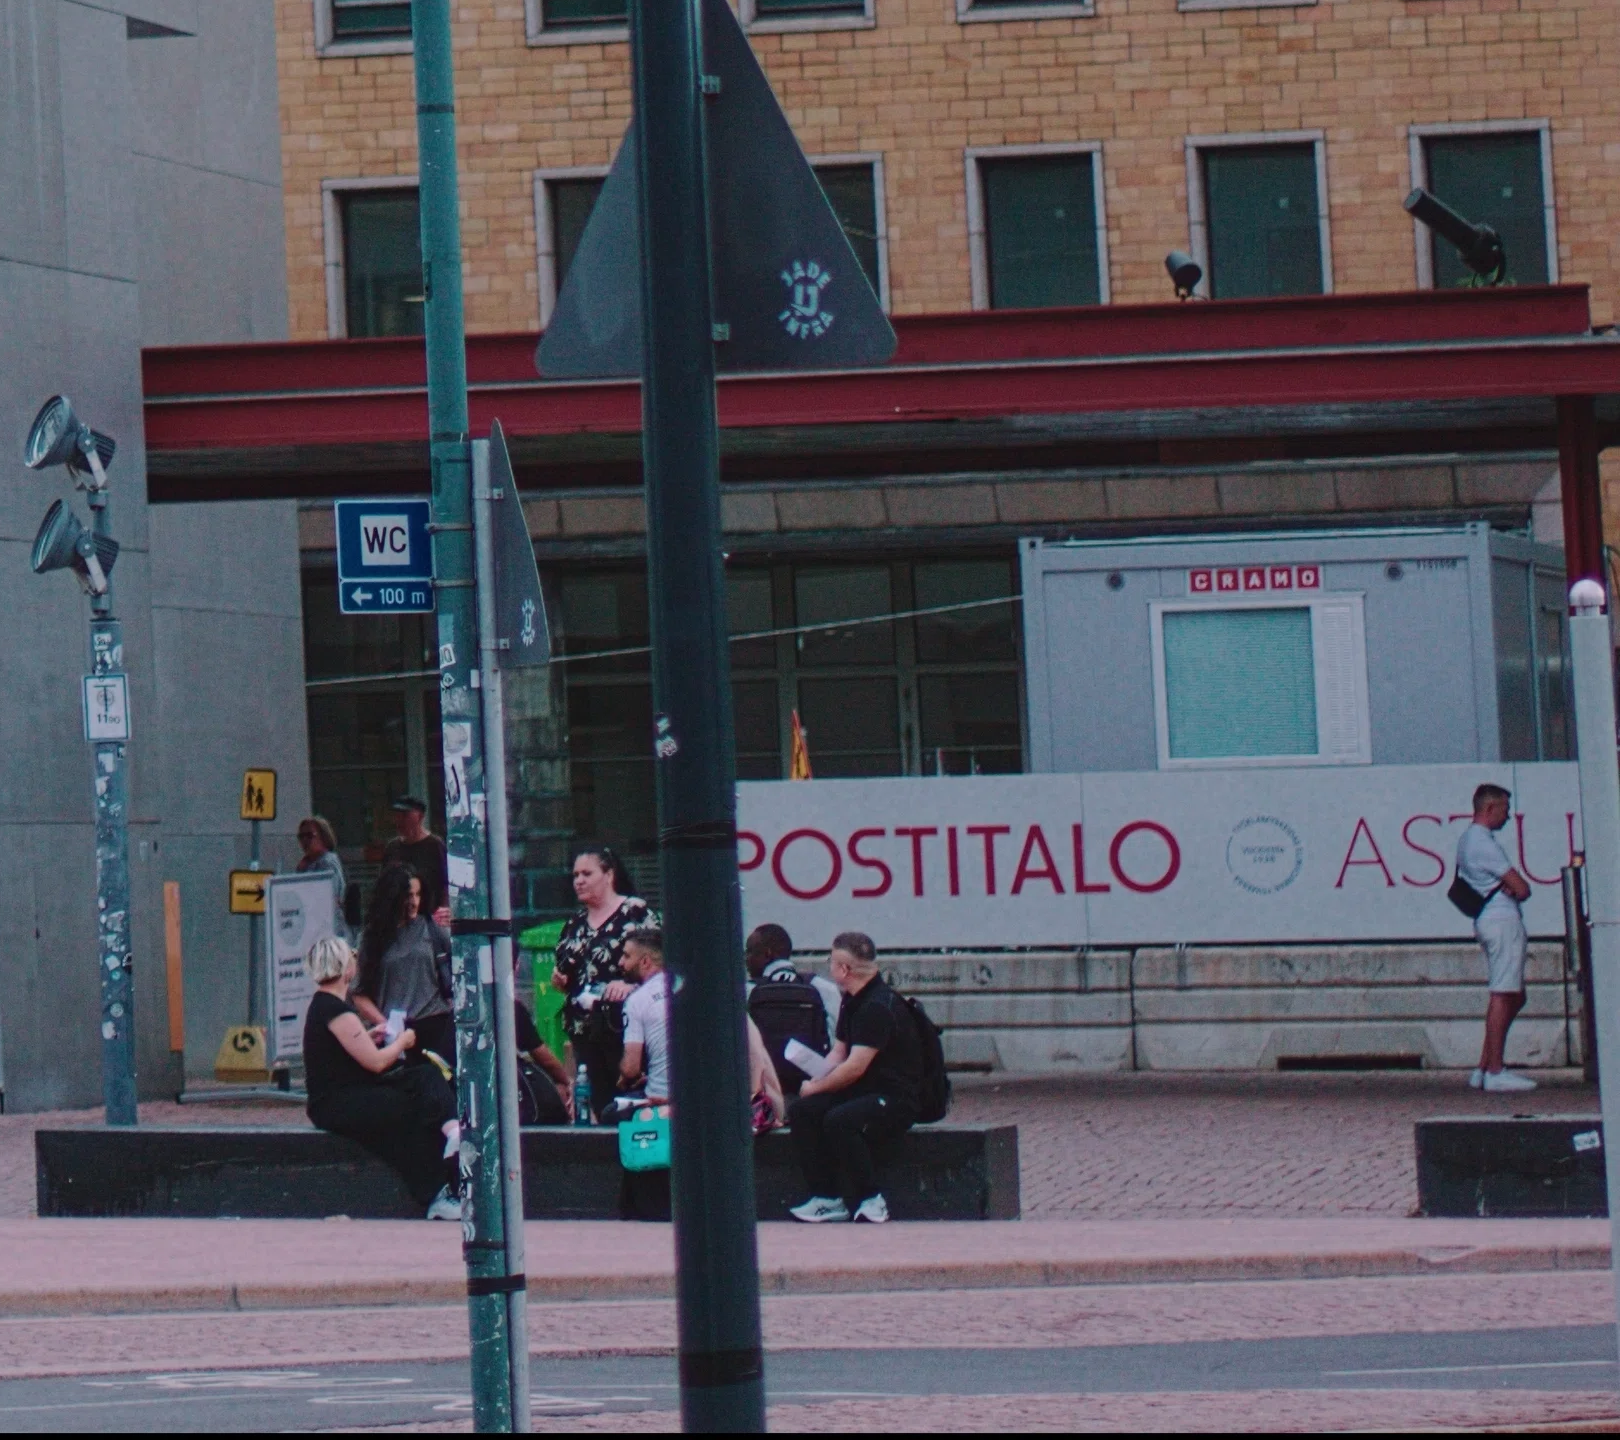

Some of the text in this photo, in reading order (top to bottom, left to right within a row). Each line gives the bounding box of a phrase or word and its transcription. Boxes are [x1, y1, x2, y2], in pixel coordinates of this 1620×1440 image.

[363, 526, 407, 554] WC
[379, 588, 425, 605] 100 m
[736, 820, 1182, 901] POSTITALO
[1334, 812, 1575, 888] ASU
